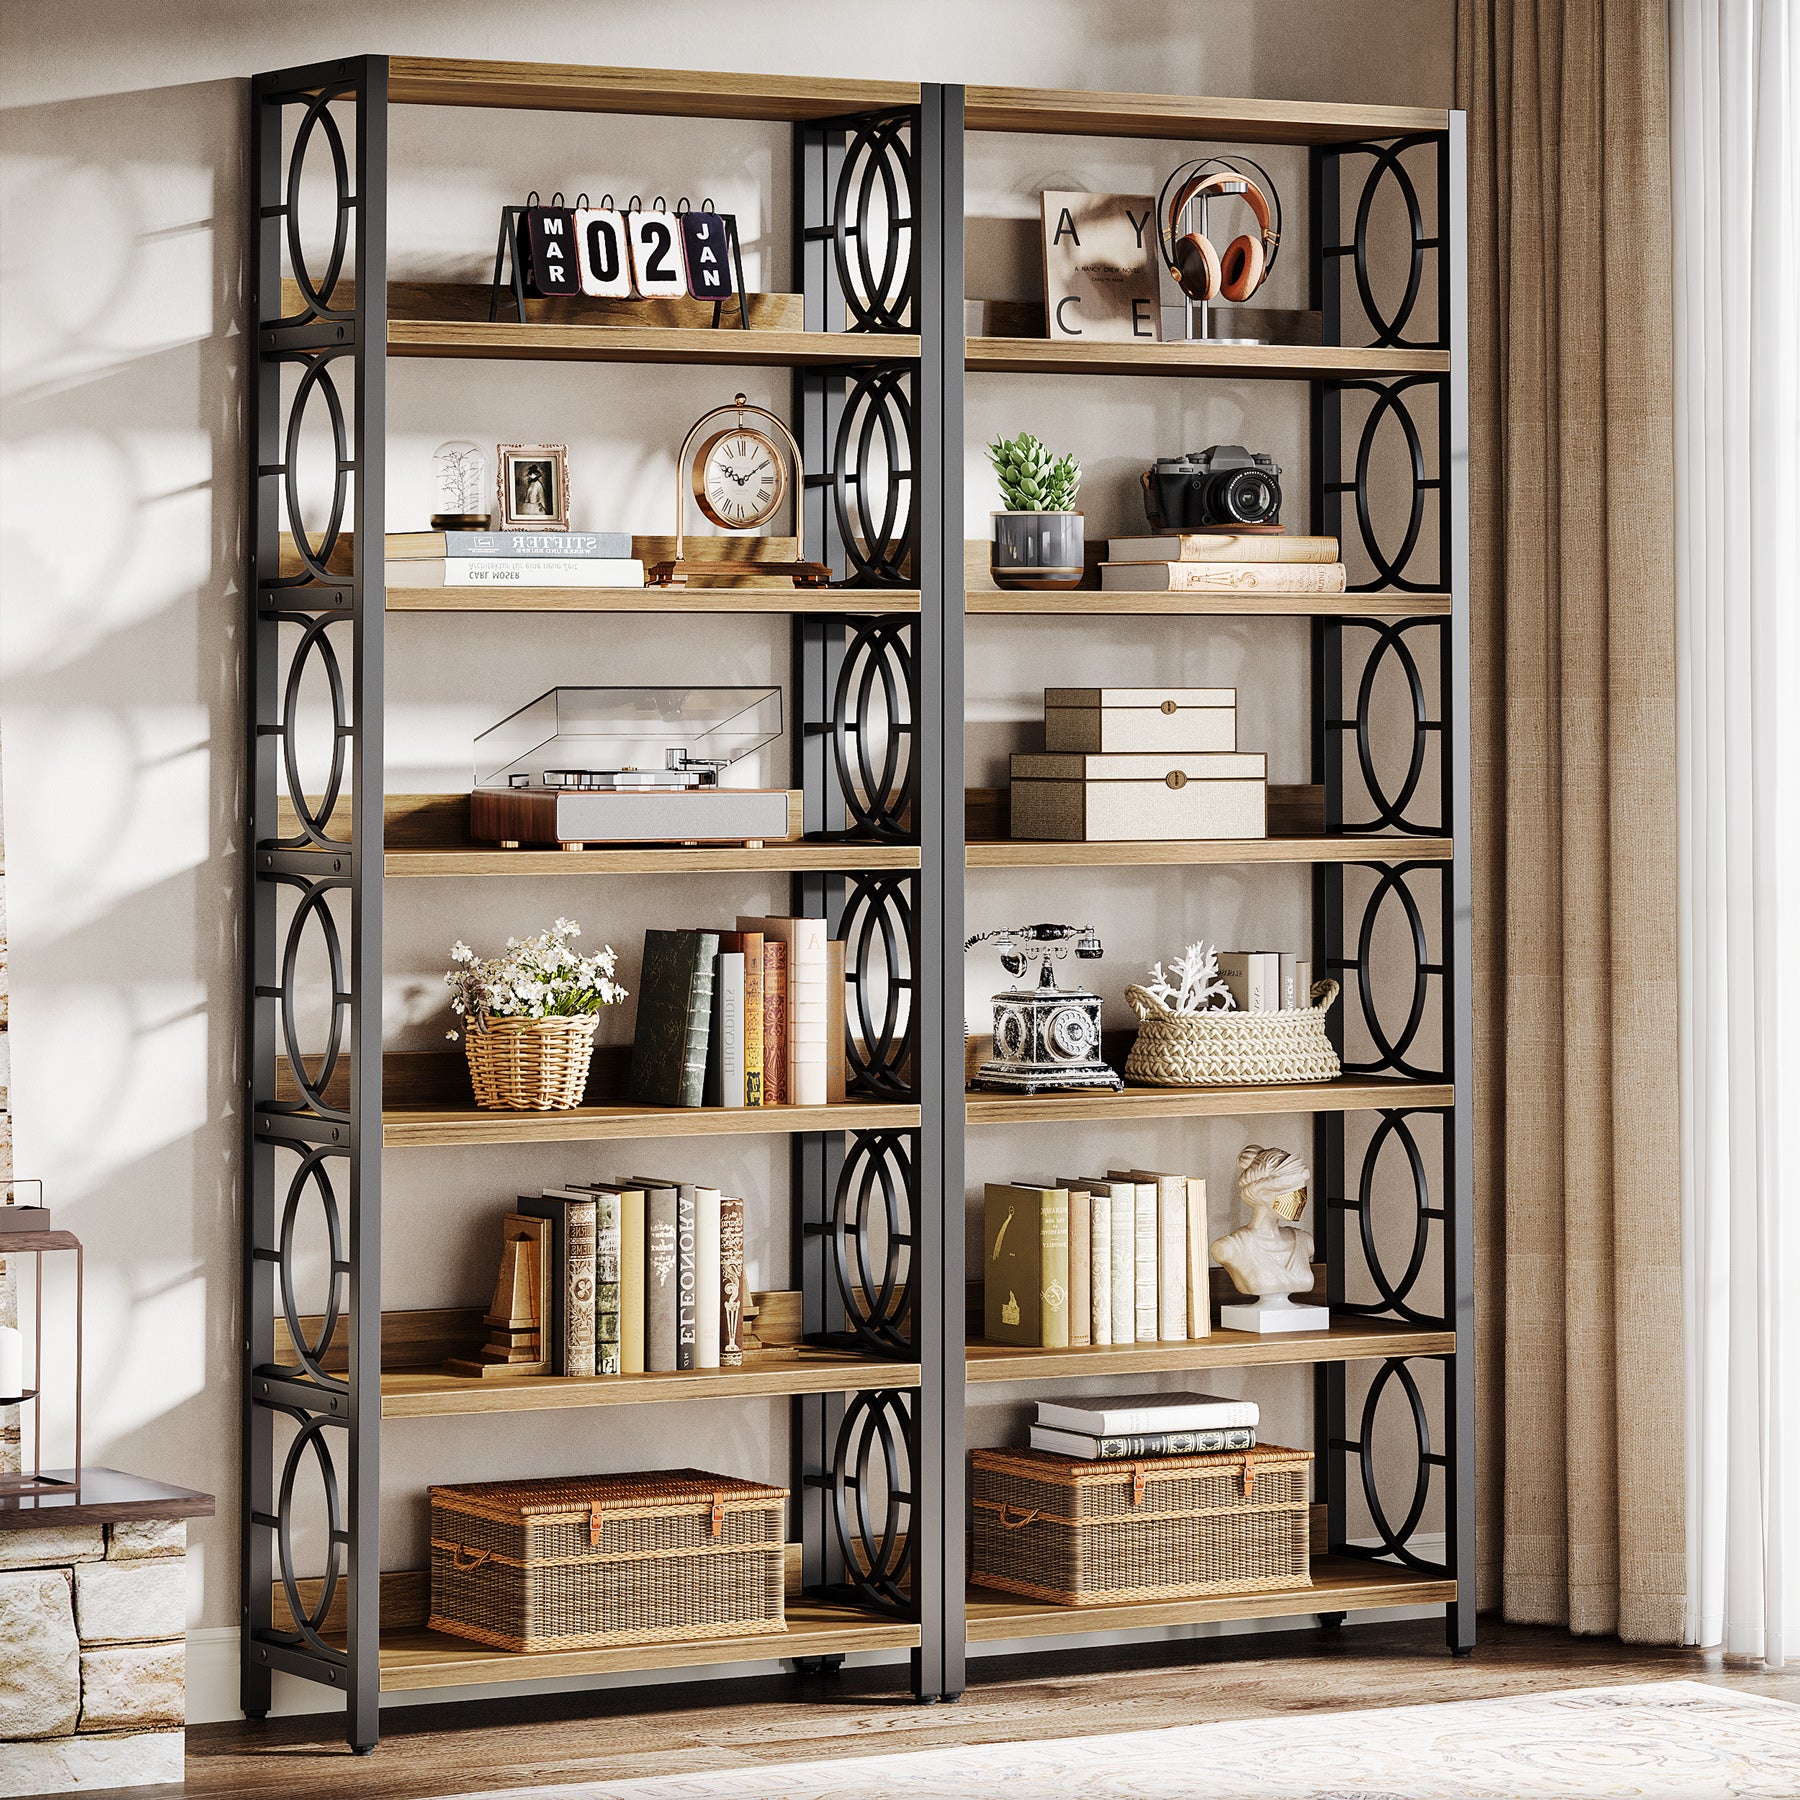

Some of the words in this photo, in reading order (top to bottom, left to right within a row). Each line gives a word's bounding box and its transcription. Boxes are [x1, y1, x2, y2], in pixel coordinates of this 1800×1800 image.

[543, 218, 565, 283] MAR
[1053, 208, 1080, 246] A
[1126, 210, 1150, 248] Y
[696, 223, 721, 287] JAN
[1056, 296, 1082, 335] C
[1131, 298, 1153, 337] E
